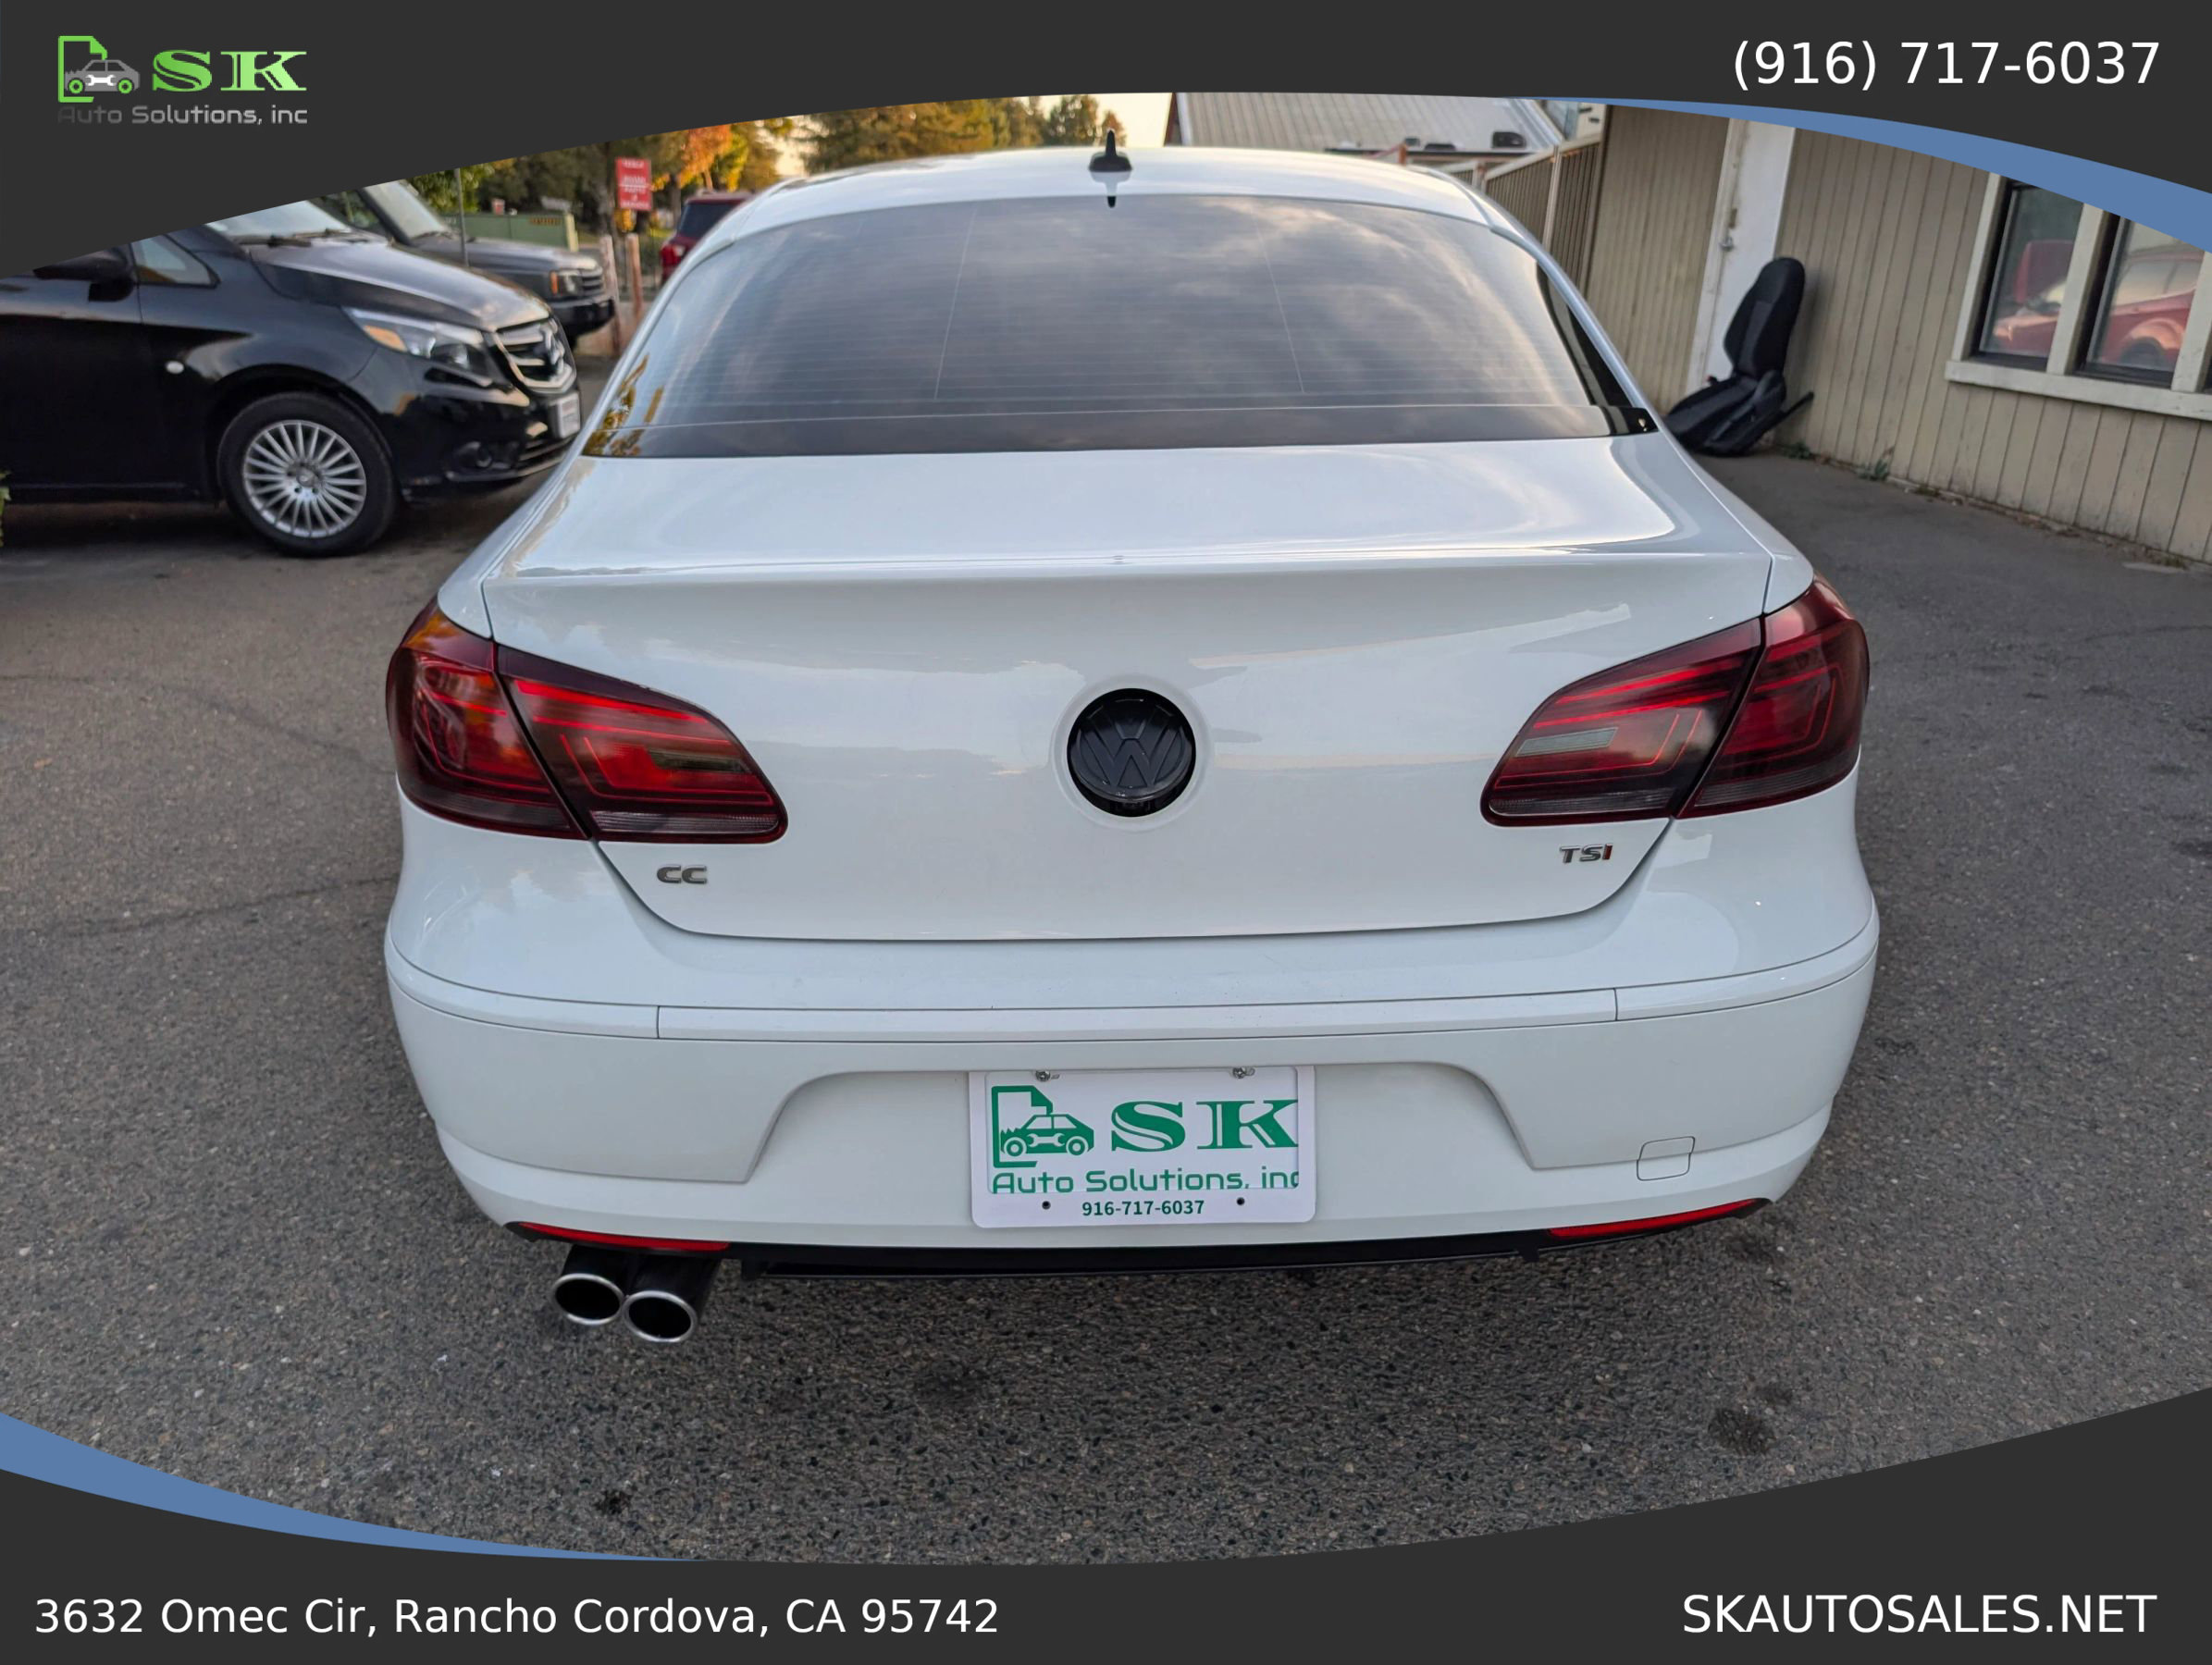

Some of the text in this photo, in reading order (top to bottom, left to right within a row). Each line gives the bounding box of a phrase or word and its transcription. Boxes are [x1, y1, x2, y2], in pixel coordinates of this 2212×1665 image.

[1559, 843, 1613, 864] TSI
[656, 864, 708, 884] CC
[1110, 1099, 1299, 1153] SK
[993, 1171, 1074, 1194] Auto
[1086, 1167, 1250, 1192] Solutions,
[1081, 1200, 1205, 1216] 916-717-6037
